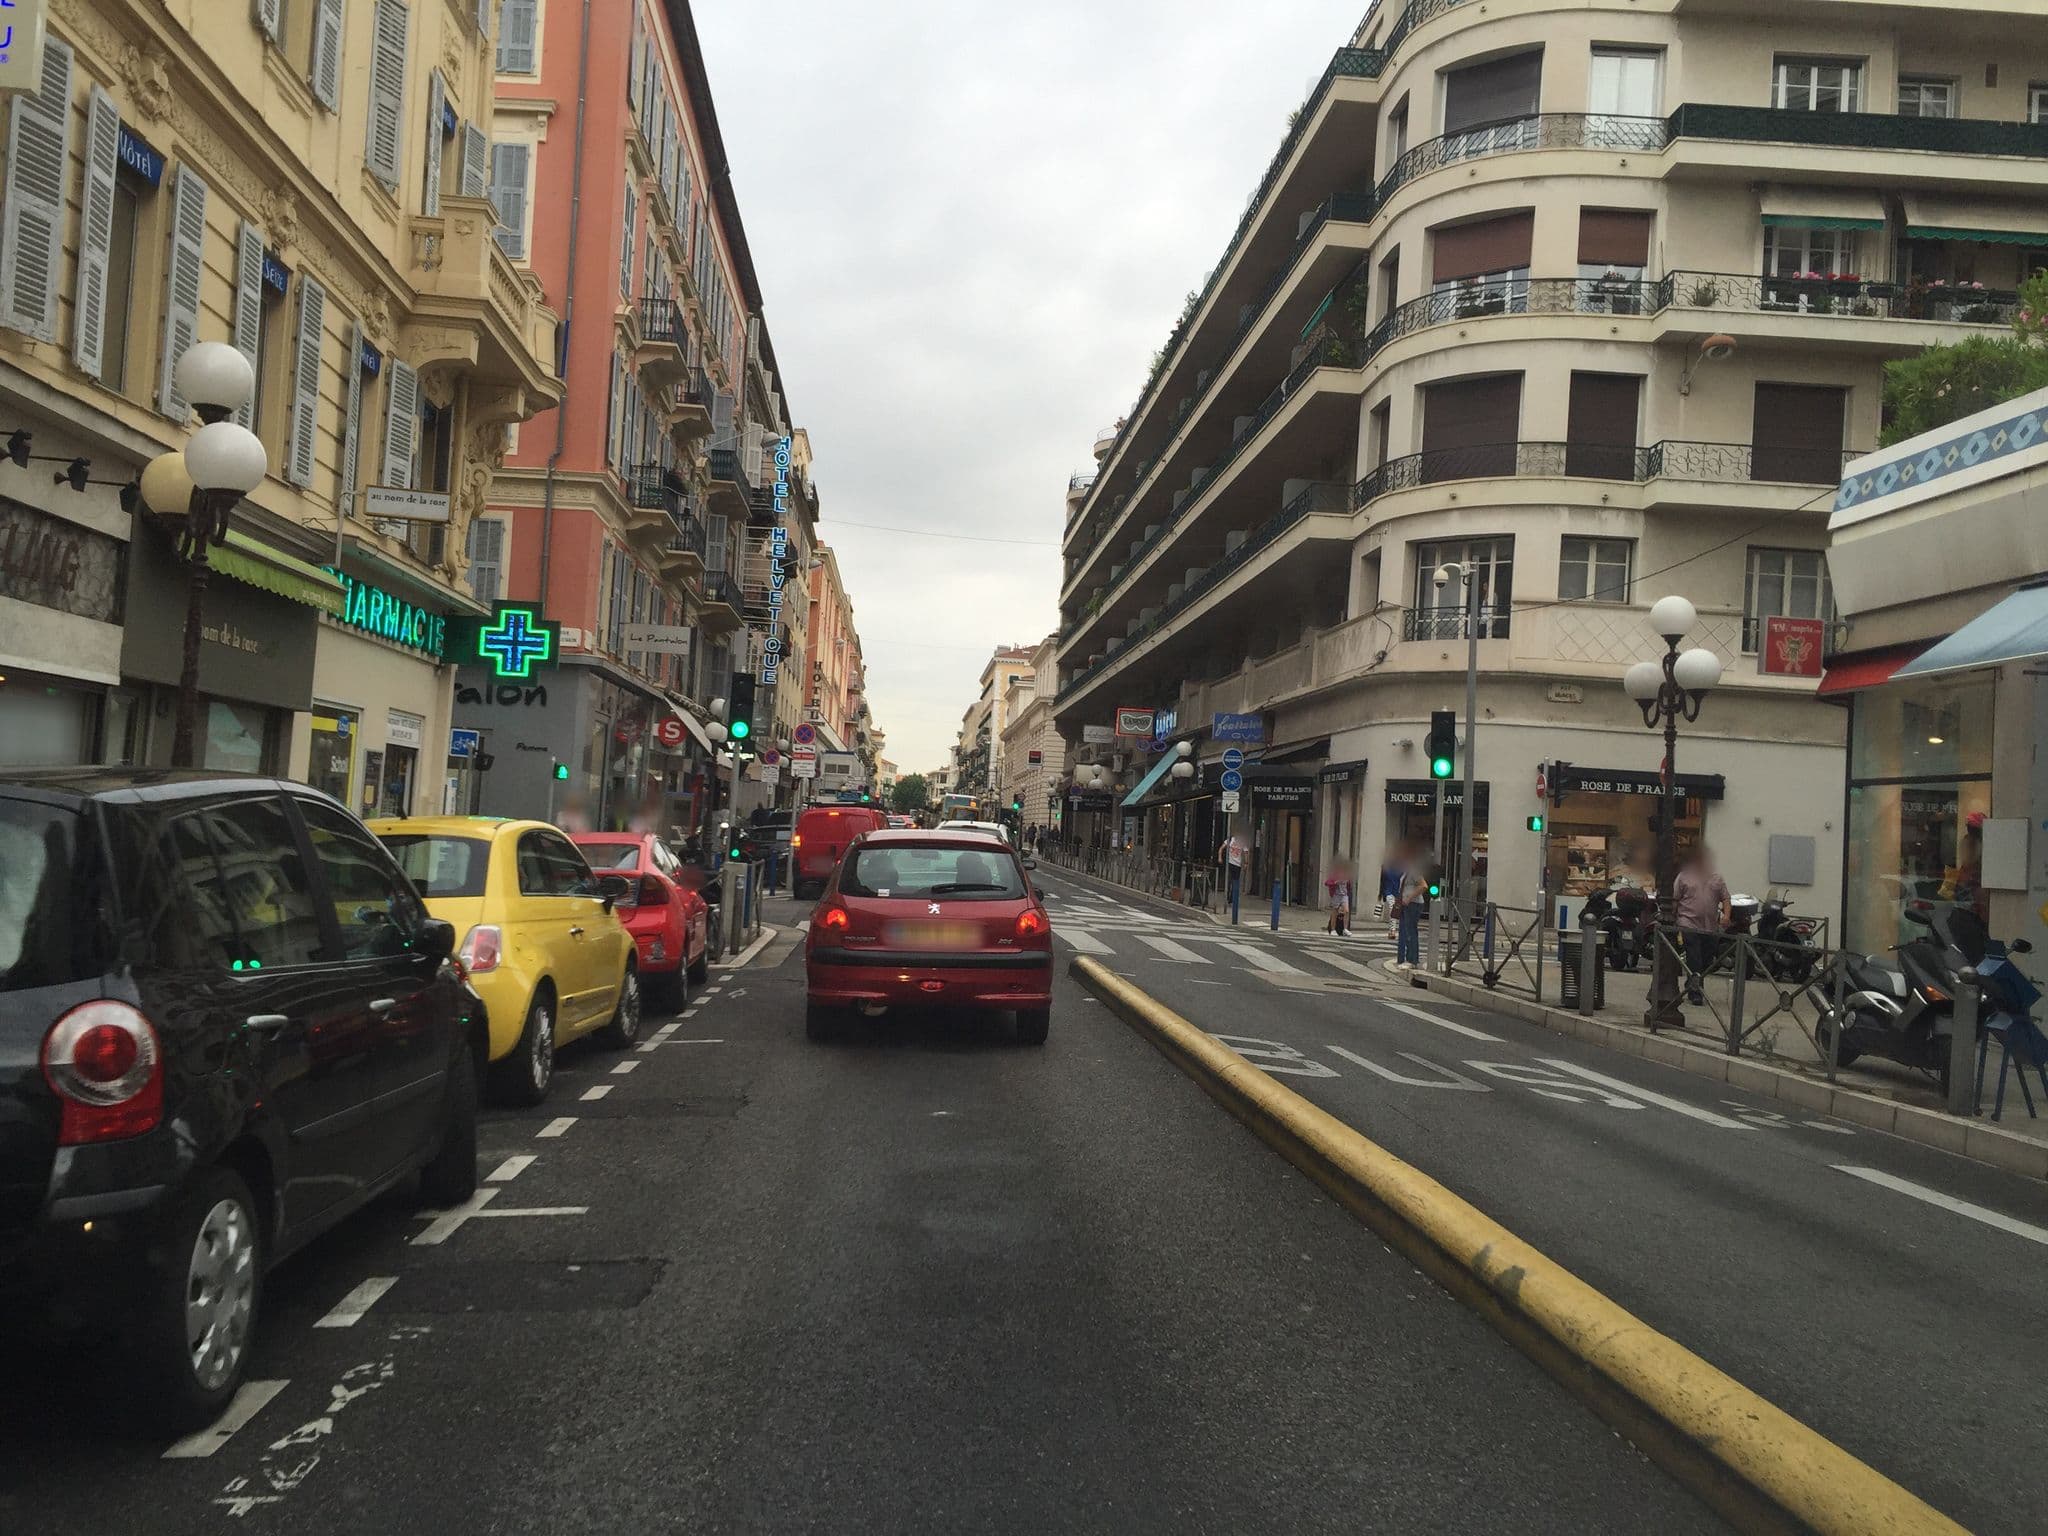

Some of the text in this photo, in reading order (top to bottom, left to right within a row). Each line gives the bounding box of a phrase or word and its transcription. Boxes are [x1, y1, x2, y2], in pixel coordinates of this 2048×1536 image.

[384, 494, 404, 503] nom
[407, 494, 417, 504] de
[420, 495, 427, 505] la
[763, 436, 791, 684] HOTEL HELVETIQUE
[320, 565, 446, 657] HARMACIE
[631, 634, 642, 642] Le
[1581, 780, 1686, 796] ROSE DE FRACE
[1390, 793, 1415, 803] ROSE
